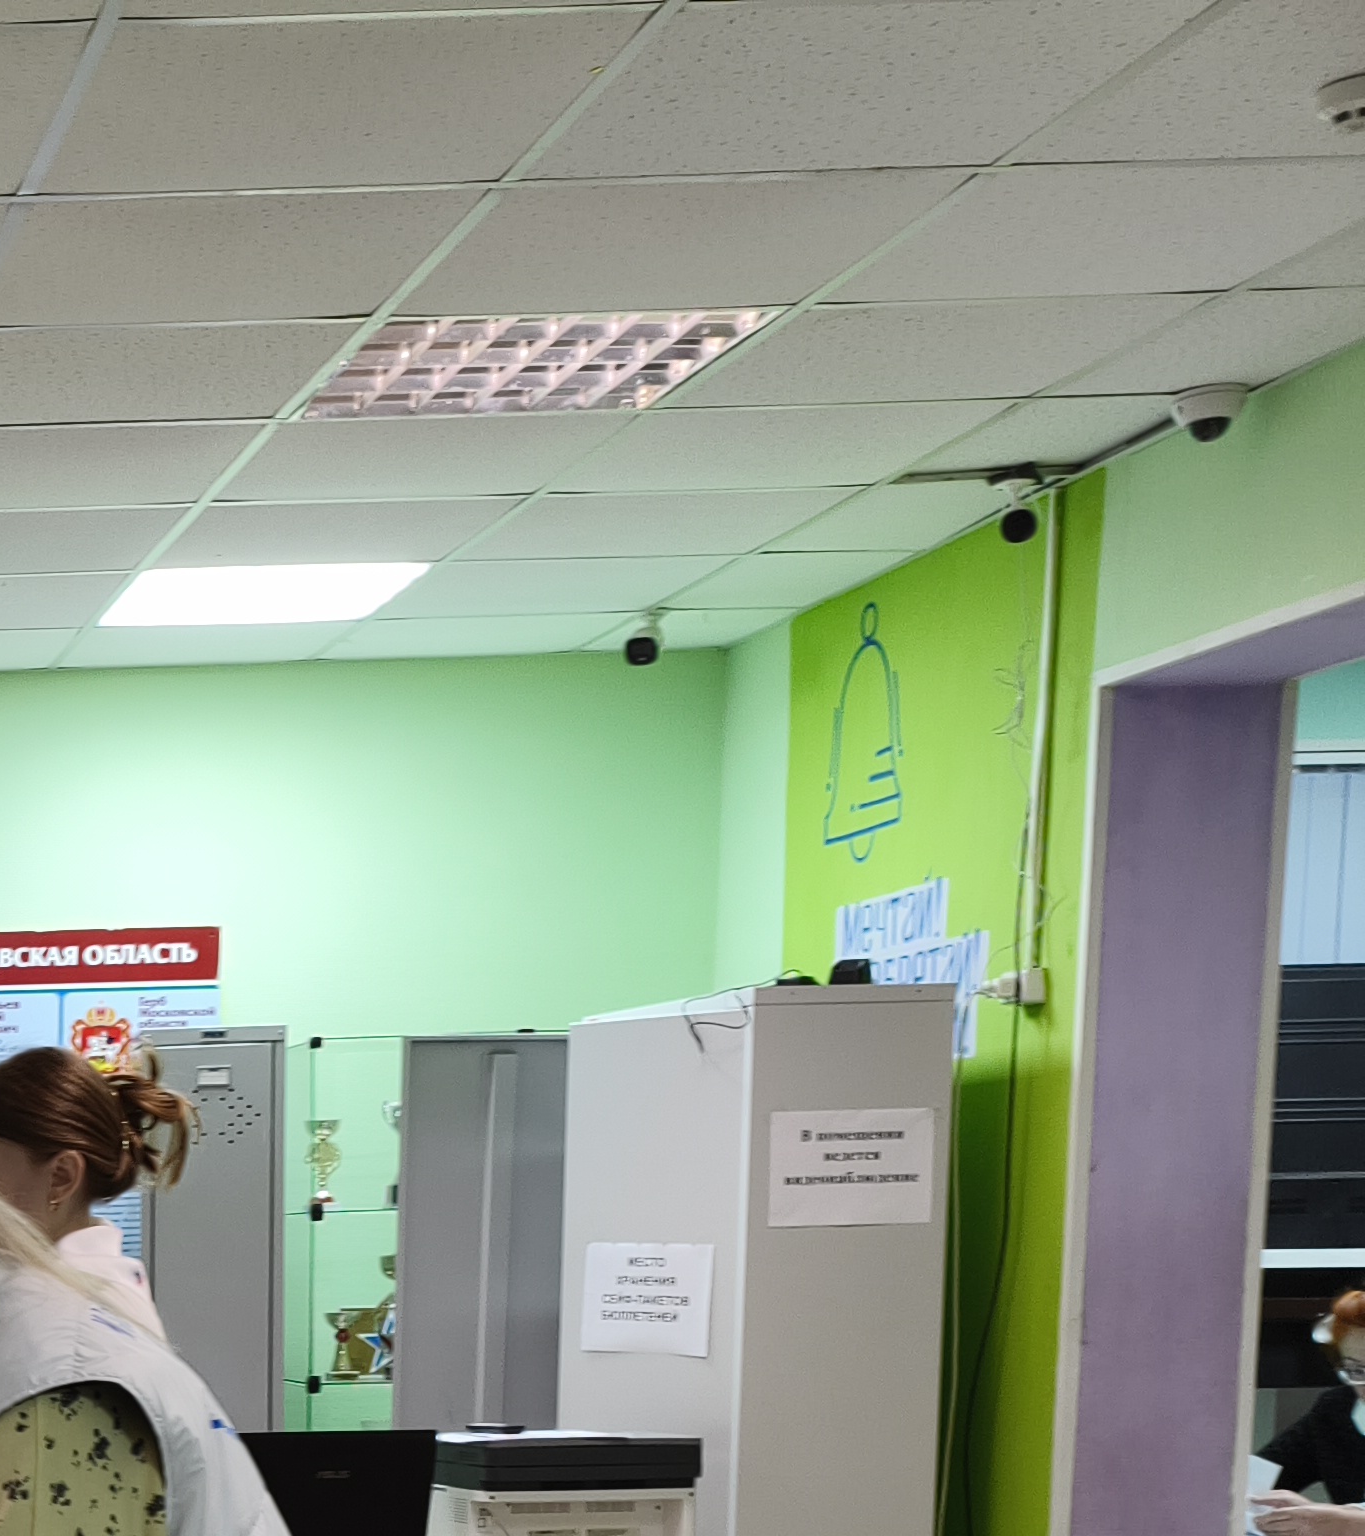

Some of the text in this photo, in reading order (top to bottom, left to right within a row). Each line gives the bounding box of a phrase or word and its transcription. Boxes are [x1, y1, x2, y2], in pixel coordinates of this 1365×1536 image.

[81, 942, 199, 967] ОБЛАСТЬ
[800, 1130, 905, 1142] В помещении
[823, 1151, 882, 1162] ведется
[783, 1171, 920, 1186] видеонаблюдение
